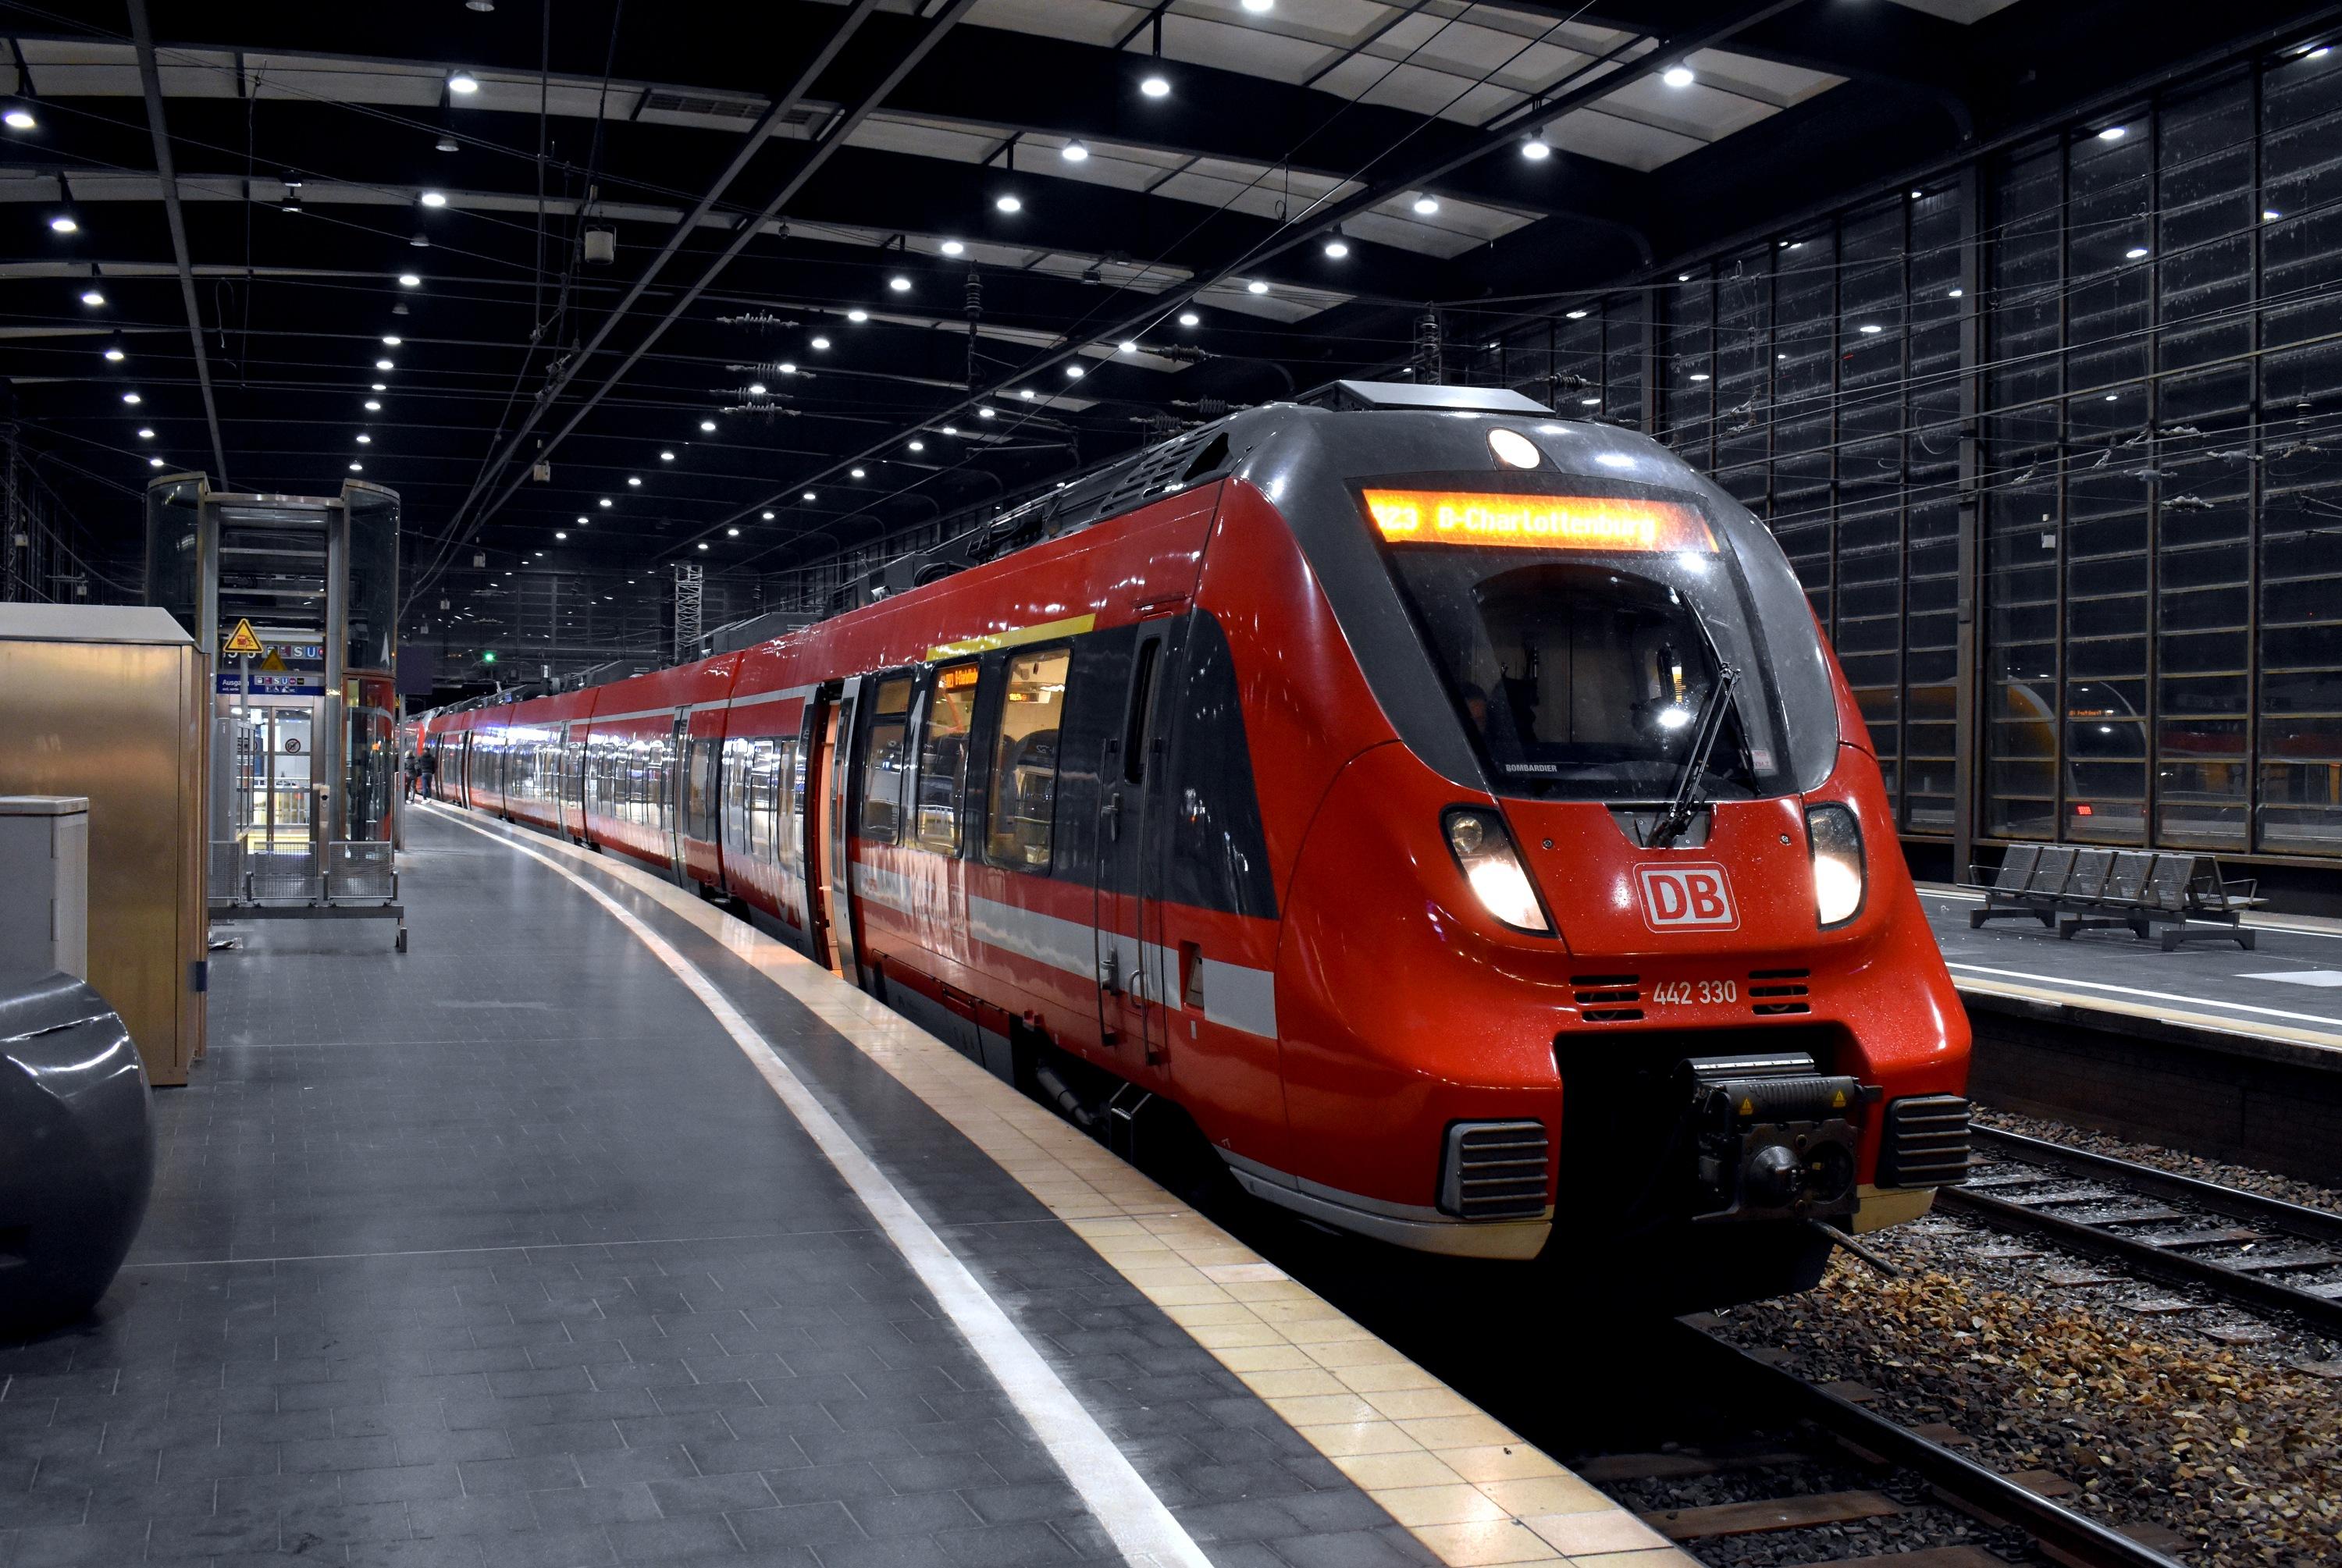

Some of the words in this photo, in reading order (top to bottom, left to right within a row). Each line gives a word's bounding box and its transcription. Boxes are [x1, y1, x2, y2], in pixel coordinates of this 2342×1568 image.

[1439, 506, 1656, 543] B-Charlottenburg
[294, 646, 303, 657] S
[307, 647, 315, 657] U
[1647, 874, 1725, 920] DB
[1653, 981, 1693, 1005] 442
[1698, 980, 1737, 1004] 330
